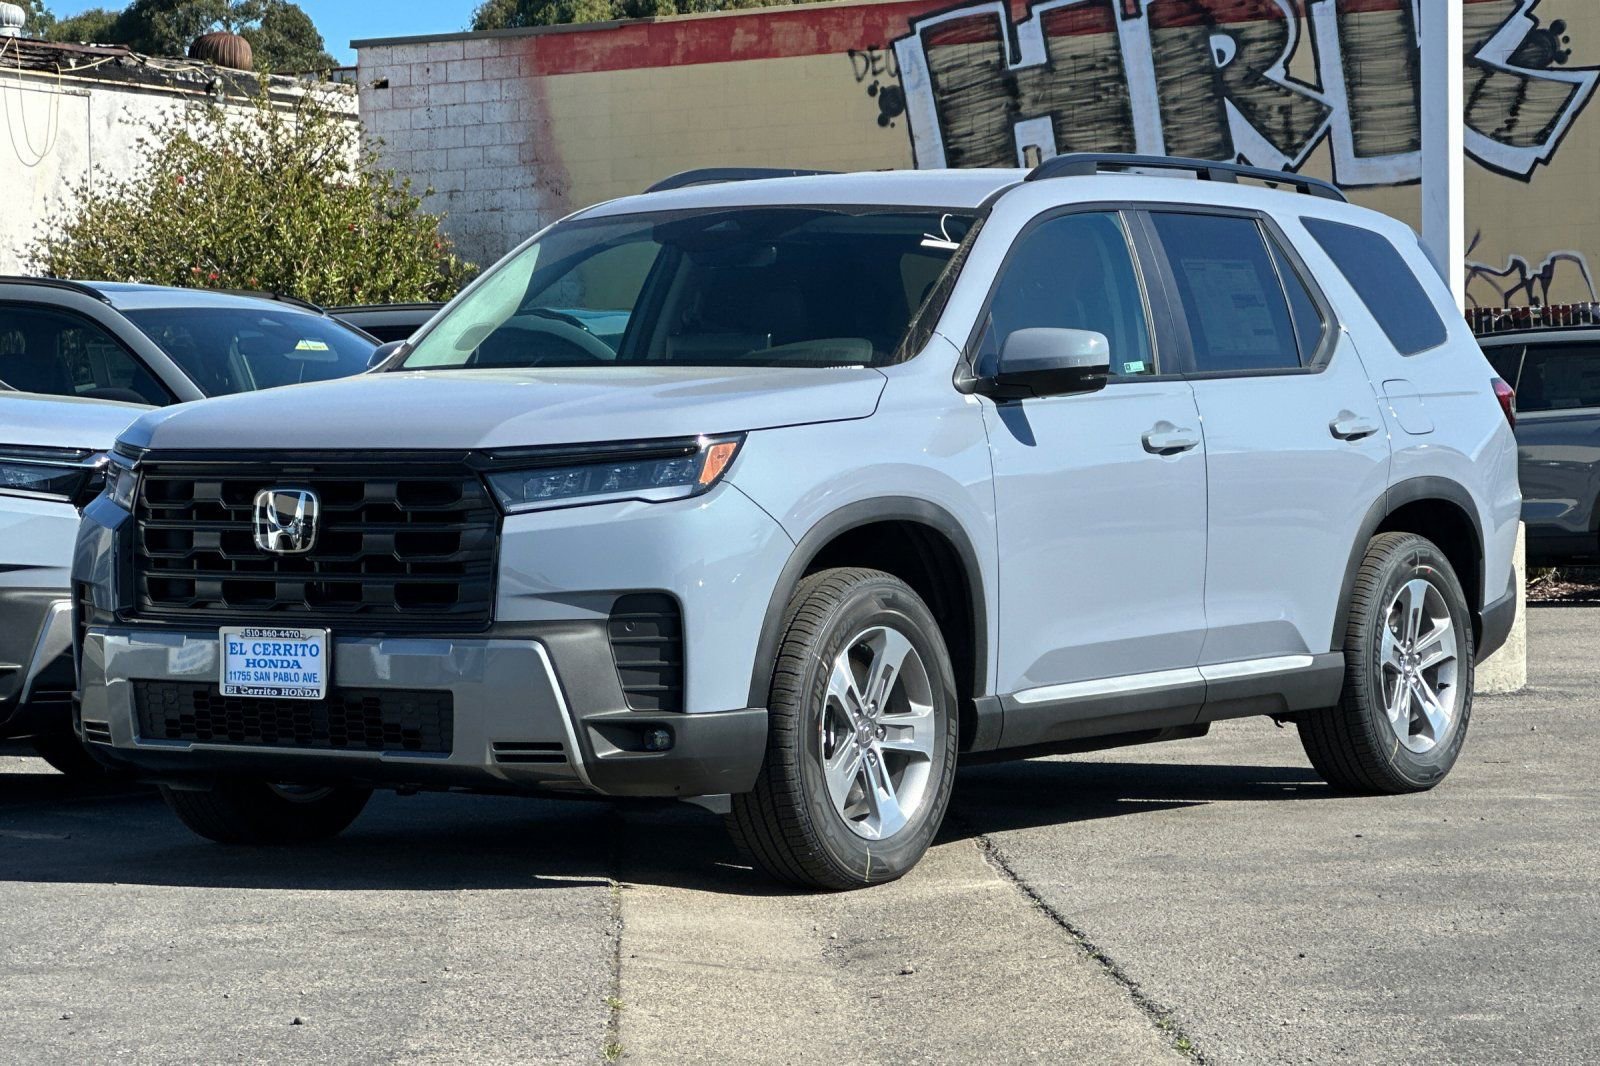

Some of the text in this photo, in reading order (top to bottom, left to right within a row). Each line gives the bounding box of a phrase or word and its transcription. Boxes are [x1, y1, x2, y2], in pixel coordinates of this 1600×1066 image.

[246, 629, 300, 638] 510-860-4470
[230, 642, 320, 657] EL CERRITO
[245, 658, 302, 669] HONDA
[229, 671, 252, 681] 11755
[253, 671, 271, 681] SAN
[273, 672, 300, 683] PABLO
[226, 686, 319, 697] El Cerrito HONDA
